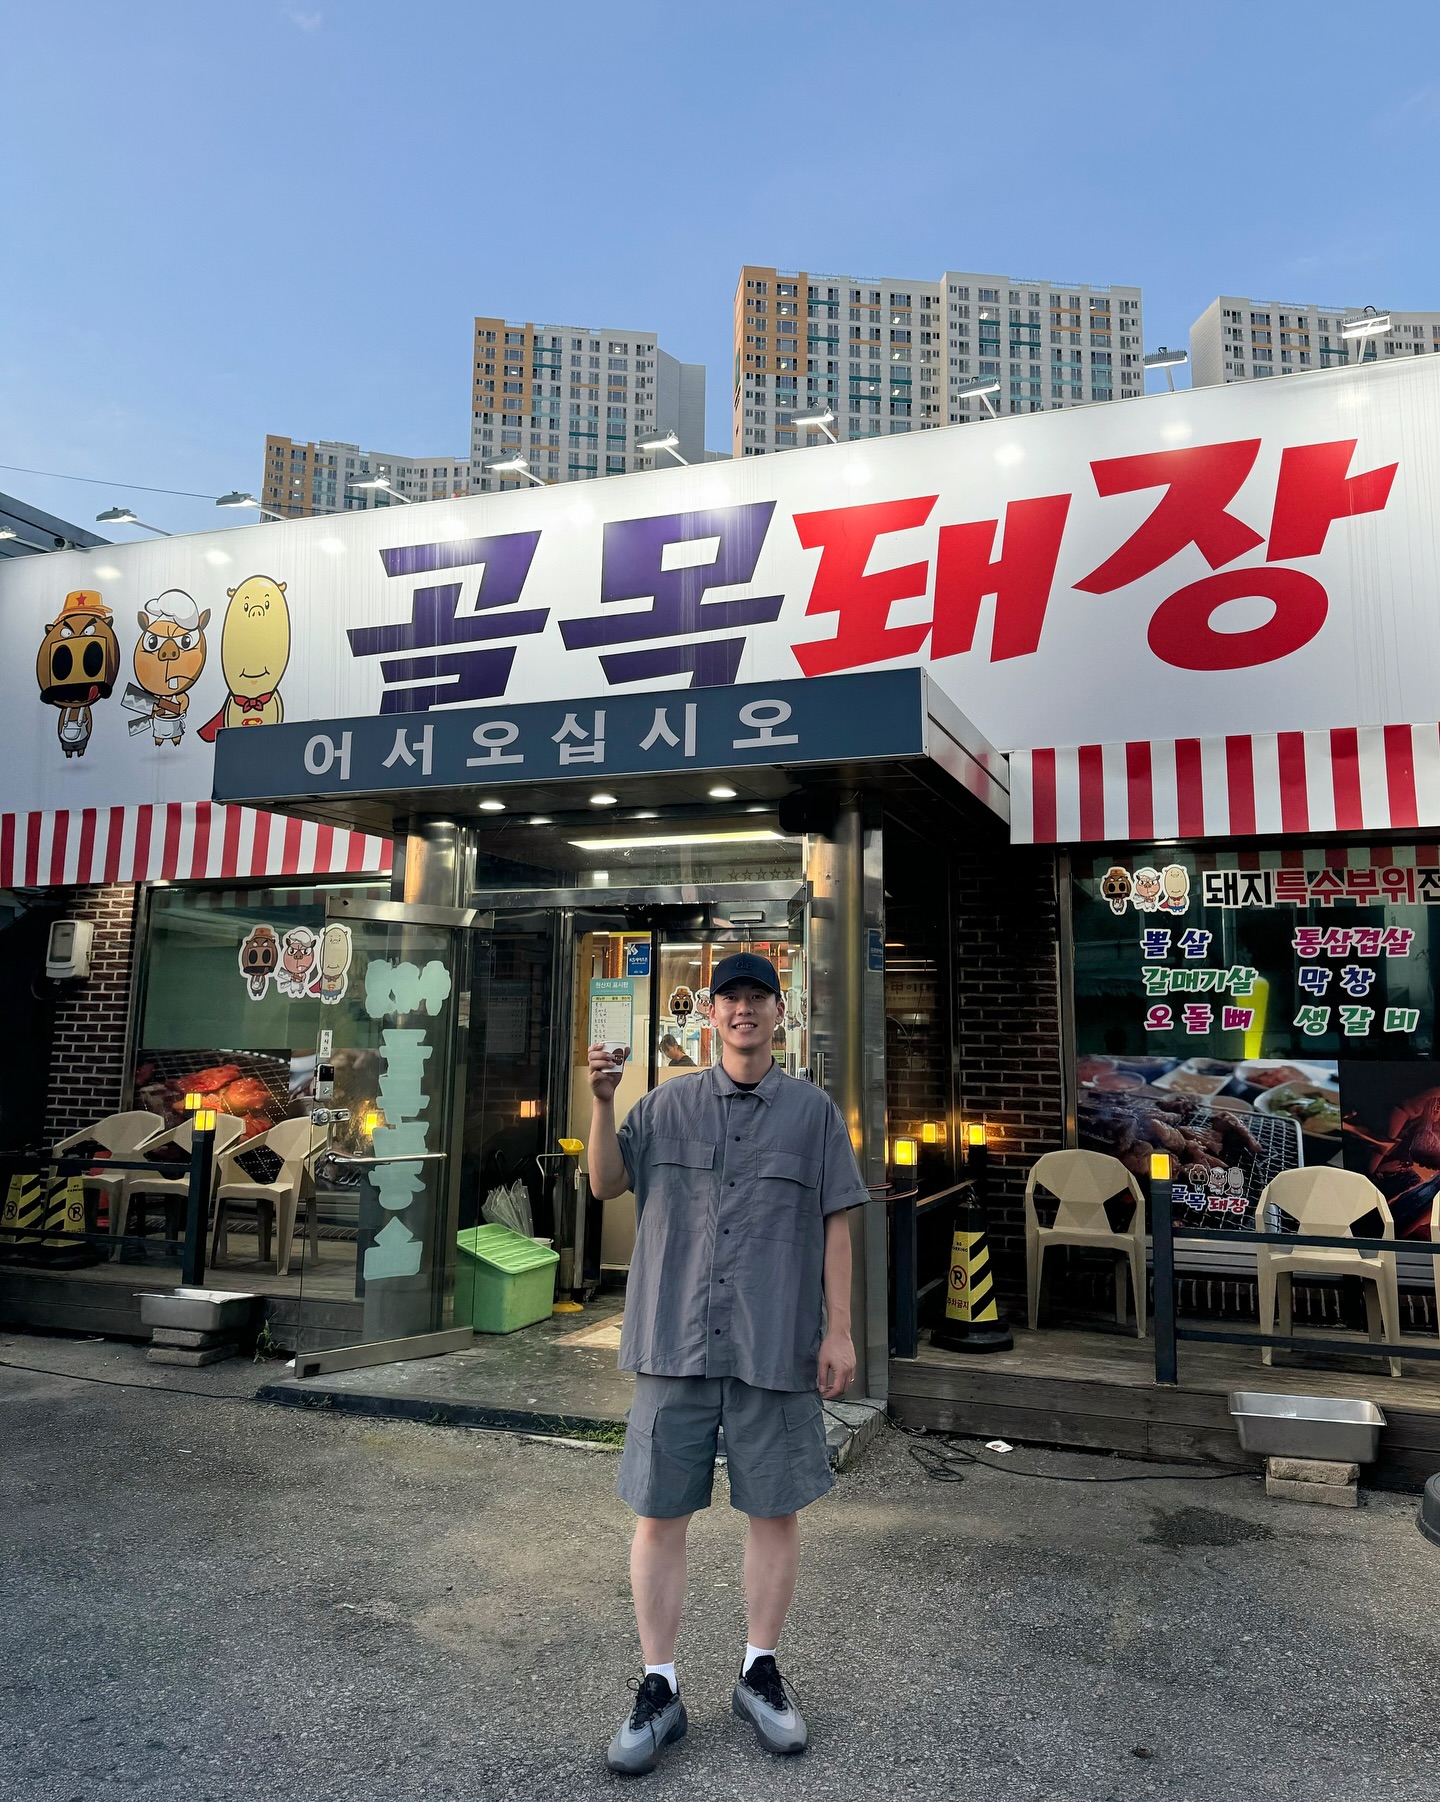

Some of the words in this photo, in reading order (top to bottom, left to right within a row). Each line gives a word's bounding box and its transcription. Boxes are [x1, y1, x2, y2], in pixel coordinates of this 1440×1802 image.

[303, 699, 799, 781] 어서오십시오
[1292, 926, 1415, 958] 통삼겹살
[1142, 965, 1259, 996] 갈매기살
